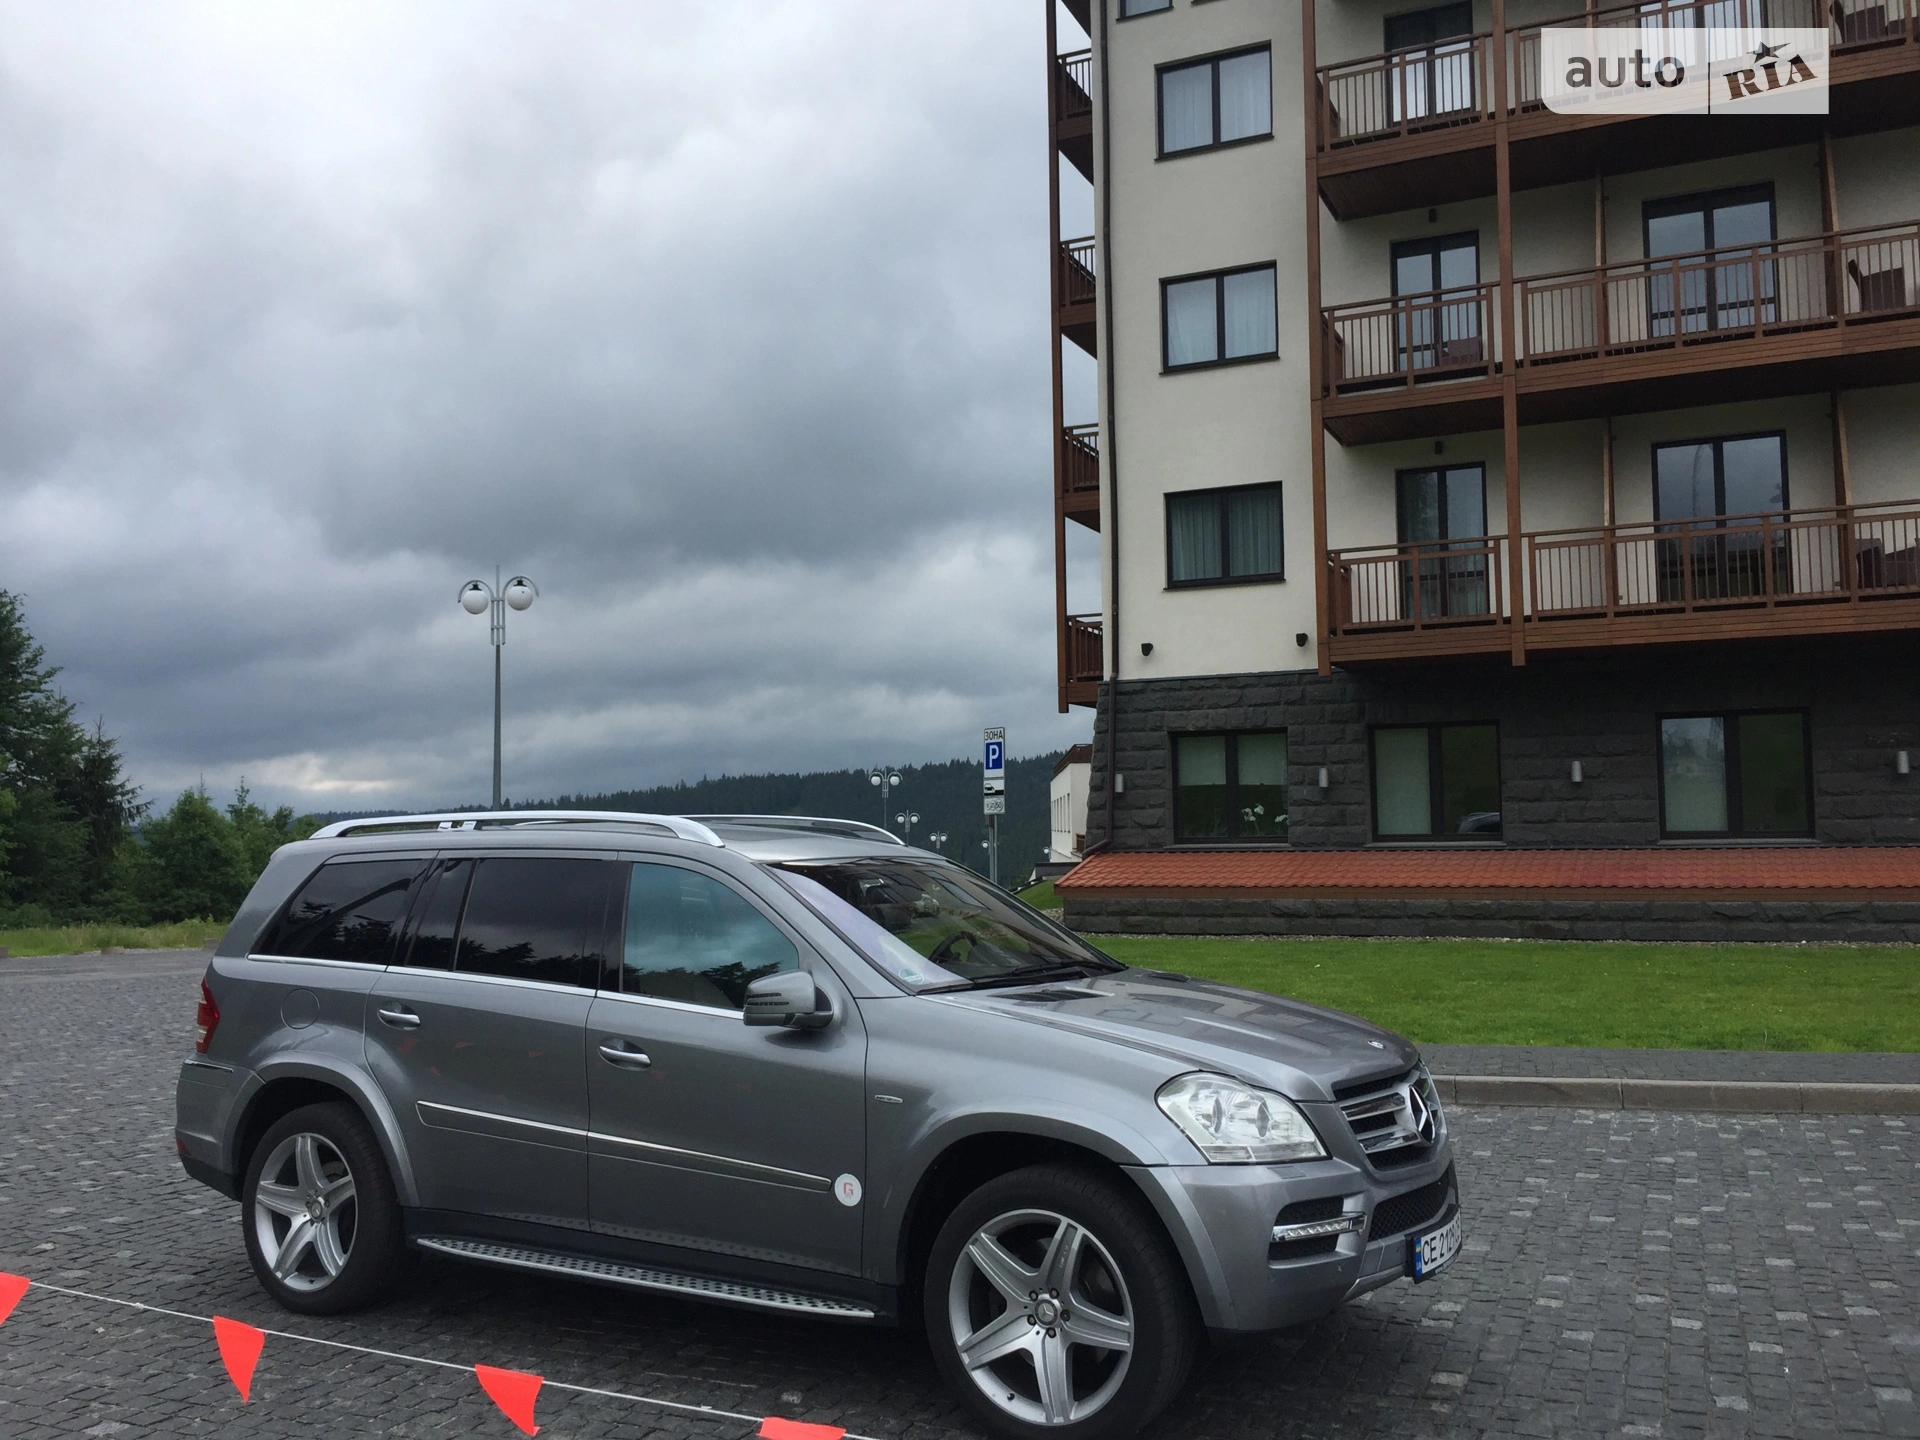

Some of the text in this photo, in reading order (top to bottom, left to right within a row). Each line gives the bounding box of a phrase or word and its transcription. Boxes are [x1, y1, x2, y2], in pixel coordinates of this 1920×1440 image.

[985, 730, 1004, 741] ЗОНА
[989, 744, 999, 768] P
[1422, 1236, 1438, 1266] CE
